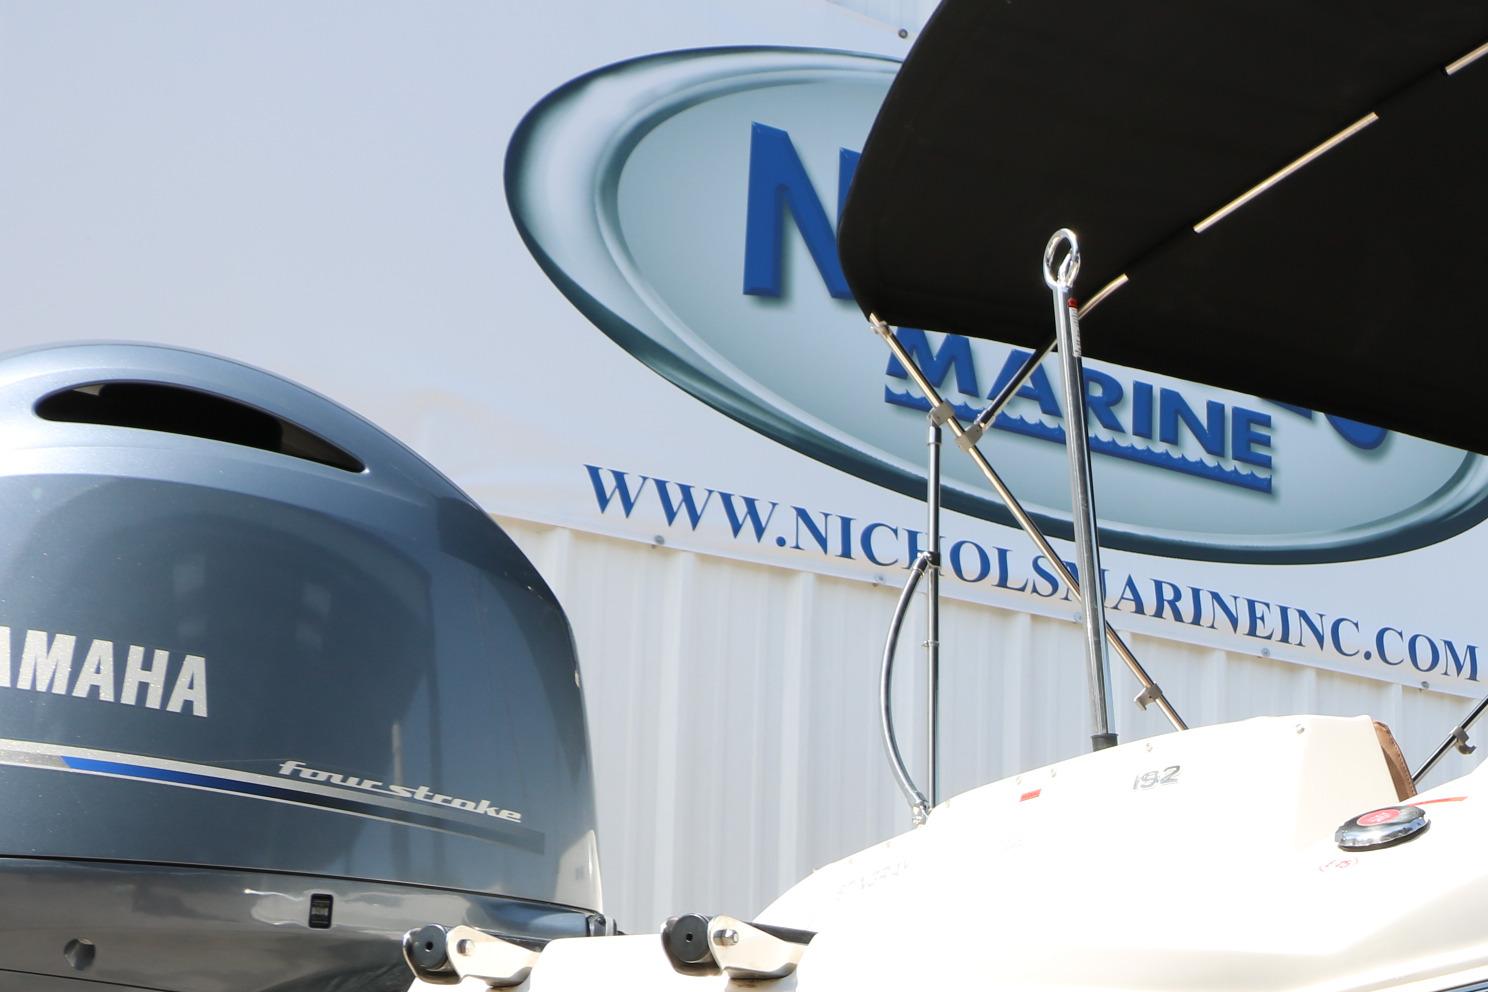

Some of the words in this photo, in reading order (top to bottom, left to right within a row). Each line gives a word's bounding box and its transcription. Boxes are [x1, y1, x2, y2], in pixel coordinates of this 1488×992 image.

[886, 326, 1272, 468] MARINE
[0, 626, 208, 718] MAHA
[1133, 765, 1181, 790] 192
